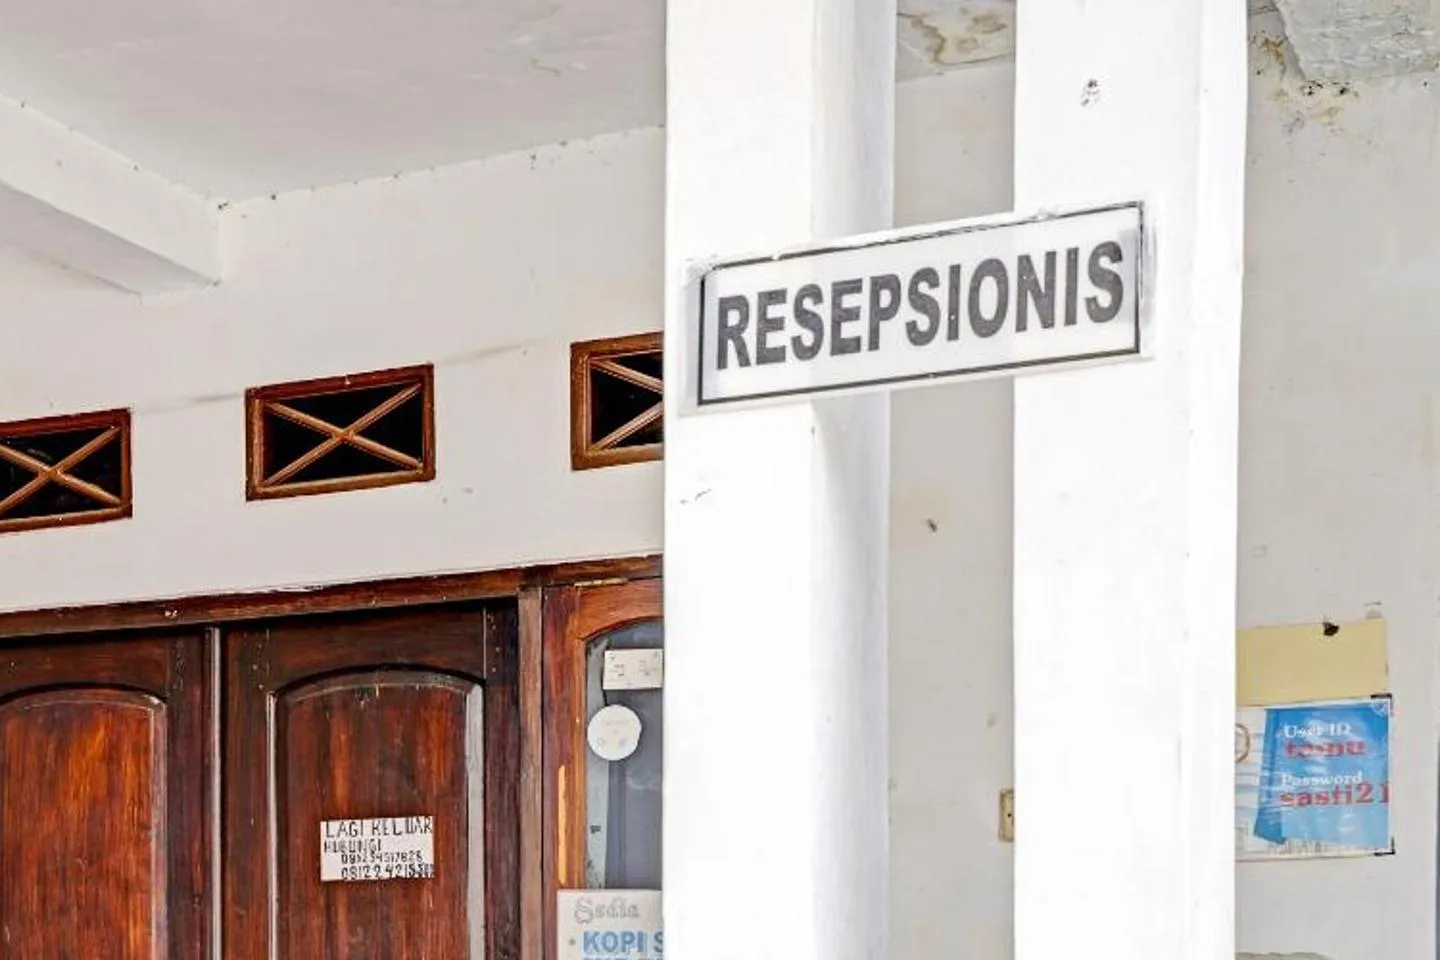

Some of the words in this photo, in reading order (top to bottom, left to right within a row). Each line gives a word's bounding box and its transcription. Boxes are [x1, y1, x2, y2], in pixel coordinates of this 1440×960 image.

[716, 240, 1124, 371] RESEPSIONIS
[1283, 723, 1323, 739] User
[1329, 722, 1352, 736] ID
[1280, 770, 1363, 787] Password
[325, 819, 364, 838] LAGI
[371, 816, 433, 836] KELUAR
[574, 896, 640, 924] Sedia
[582, 930, 645, 953] KOPI
